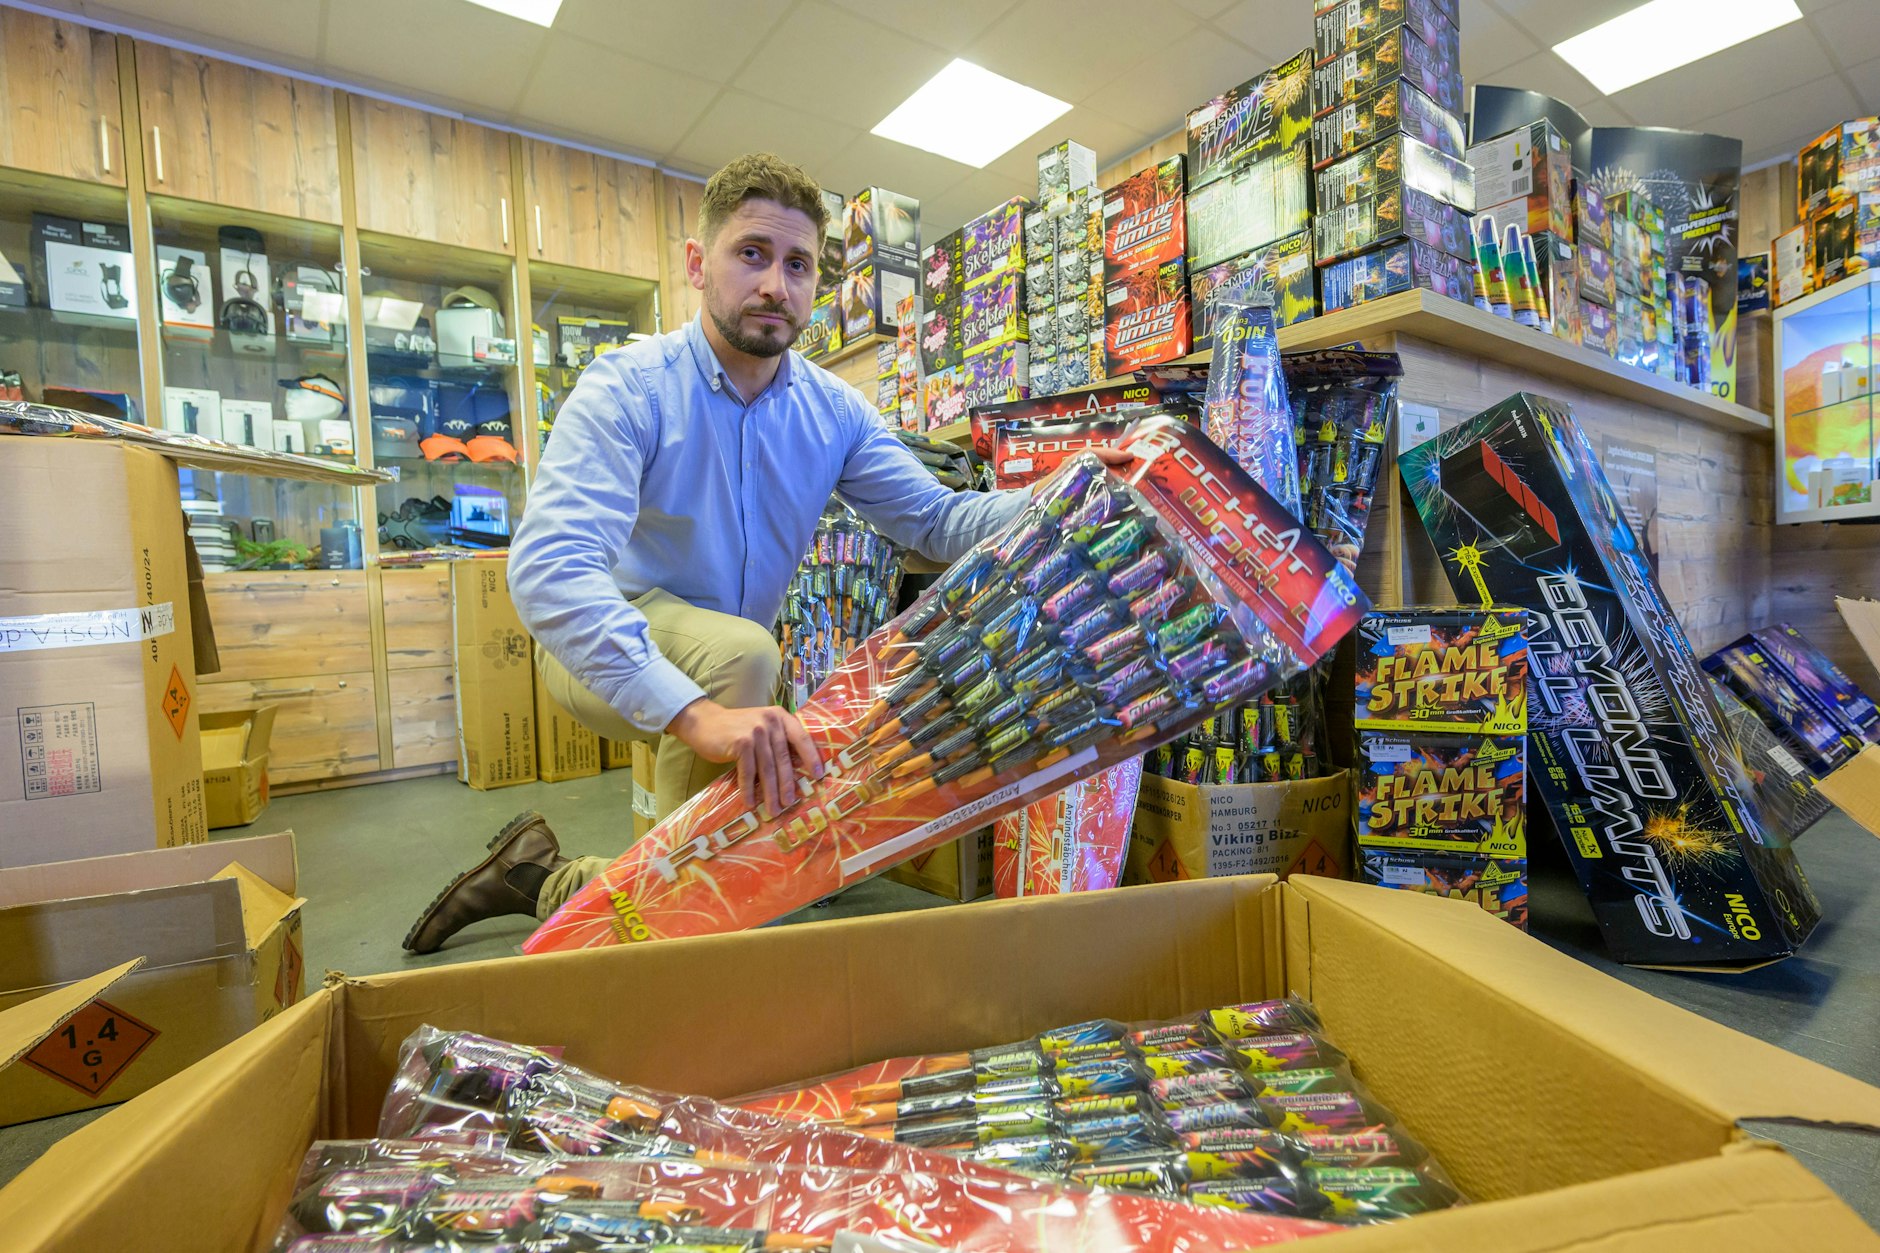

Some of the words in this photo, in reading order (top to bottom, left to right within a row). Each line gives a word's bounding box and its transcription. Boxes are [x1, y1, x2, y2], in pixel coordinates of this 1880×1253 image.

[1278, 59, 1300, 77] NICO
[1200, 97, 1251, 141] SEISMIC
[1199, 98, 1274, 175] WAVE
[1159, 160, 1179, 176] NICO
[1118, 207, 1152, 234] OUT
[1154, 200, 1175, 216] OF
[1113, 213, 1174, 254] LIMITS
[1136, 235, 1172, 254] ORIGINAL
[1279, 238, 1300, 253] NICO
[1160, 263, 1178, 276] NICO
[1119, 306, 1153, 331] OUT
[1156, 300, 1177, 314] OF
[1114, 314, 1175, 349] LIMITS
[1136, 335, 1173, 351] ORIGINAL
[1123, 387, 1150, 399] NICO
[1711, 381, 1730, 397] CO
[1145, 430, 1313, 576] ROCKET
[1187, 535, 1219, 567] RAKETEN
[1325, 570, 1357, 607] NICO
[1362, 617, 1385, 631] 41
[1619, 551, 1718, 735] BEYOND
[1377, 641, 1499, 683] FLAME
[1367, 666, 1508, 712] STRIKE
[1537, 574, 1678, 800] BEYOND
[1615, 561, 1664, 658] ALL
[1667, 669, 1764, 846] LIMITS
[1409, 709, 1427, 719] 30
[522, 717, 530, 741] CHINA
[1493, 722, 1521, 731] NICO
[504, 712, 512, 779] Hamsterkauf
[522, 743, 530, 752] IN
[1364, 737, 1385, 746] 41
[522, 754, 531, 777] MADE
[1528, 610, 1579, 714] ALL
[1561, 728, 1692, 941] LIMITS
[1376, 763, 1496, 800] FLAME
[925, 783, 1020, 834] Anzündstäbchen
[1211, 796, 1233, 805] NICO
[1303, 793, 1342, 815] NICO
[1367, 788, 1504, 829] STRIKE
[1211, 807, 1257, 818] HAMBURG
[1212, 824, 1231, 832] No.3
[1238, 820, 1268, 831] 05217
[1273, 819, 1281, 827] 11
[1408, 827, 1428, 837] 30
[1062, 803, 1075, 881] Anzündstäbchen
[1212, 831, 1264, 846] Viking
[1269, 829, 1300, 841] Bizz
[1573, 830, 1589, 856] zünden!
[1581, 830, 1589, 842] Nur
[1212, 847, 1255, 858] PACKING:
[1257, 846, 1269, 854] 8/1
[1490, 842, 1517, 851] NICO
[1159, 855, 1179, 879] 1.4
[1213, 855, 1289, 870] 1395-F2-0492/2016
[1300, 855, 1326, 876] 1.4
[1368, 857, 1389, 866] 41
[610, 890, 650, 942] NICO
[1725, 893, 1761, 941] NICO
[1723, 913, 1741, 940] Europe
[61, 1017, 118, 1049] 1.4
[1229, 1014, 1241, 1036] NICO
[1145, 1036, 1186, 1046] Power-Effekte
[1249, 1041, 1293, 1050] Power-Effekte
[82, 1050, 103, 1066] G
[90, 1072, 98, 1083] 1
[1070, 1095, 1137, 1112] TURBO
[1183, 1103, 1239, 1128] FLASH
[1201, 1142, 1254, 1152] Power-Effekte
[1084, 1169, 1160, 1188] TURBO
[1322, 1184, 1373, 1193] Power-Effekte
[1208, 1184, 1263, 1195] Power-Effekte
